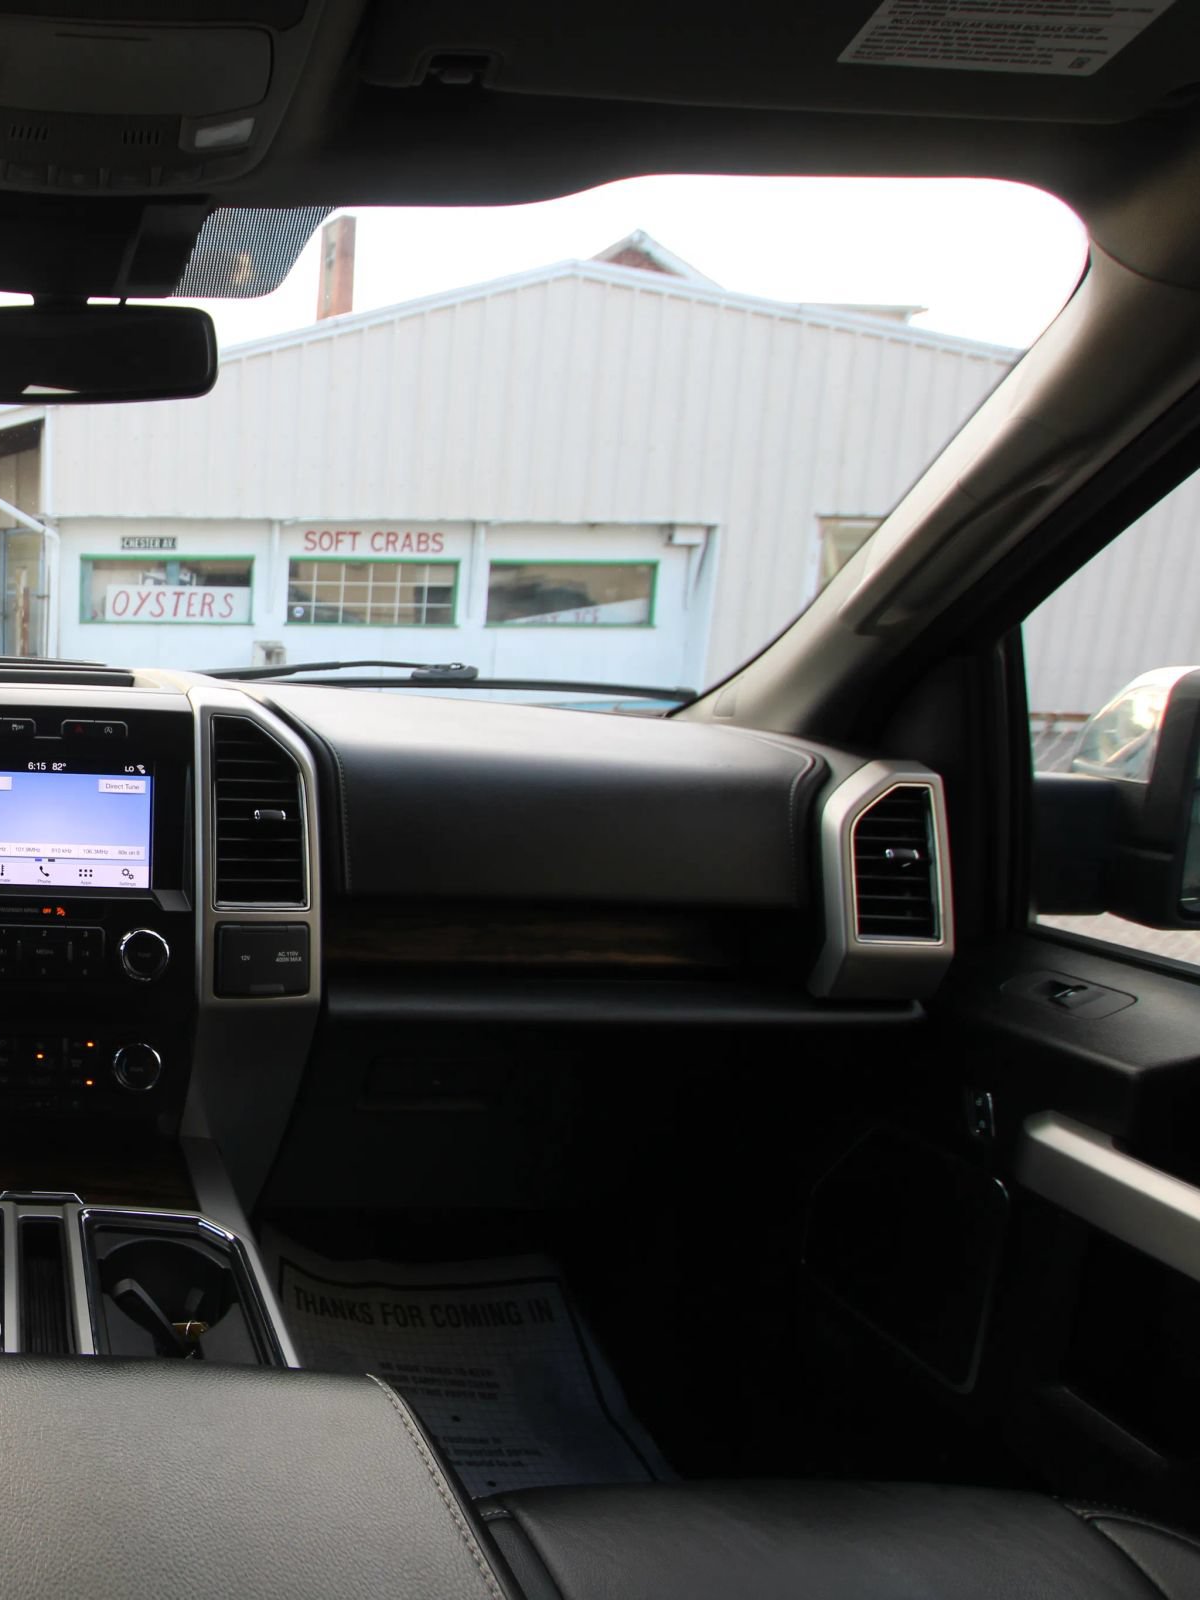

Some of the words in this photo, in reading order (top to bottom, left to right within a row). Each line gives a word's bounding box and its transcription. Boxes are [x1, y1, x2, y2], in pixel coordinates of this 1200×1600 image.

[123, 537, 160, 549] CHESTER
[303, 530, 362, 552] SOFT
[370, 532, 445, 553] CRABS
[111, 590, 235, 618] OYSTERS
[27, 762, 46, 770] 6:15
[124, 765, 135, 773] LO
[105, 782, 122, 791] Direct
[123, 783, 140, 791] Tune
[294, 1284, 375, 1326] THANKS
[378, 1302, 425, 1328] FOR
[428, 1300, 524, 1328] COMING
[526, 1297, 556, 1323] IN
